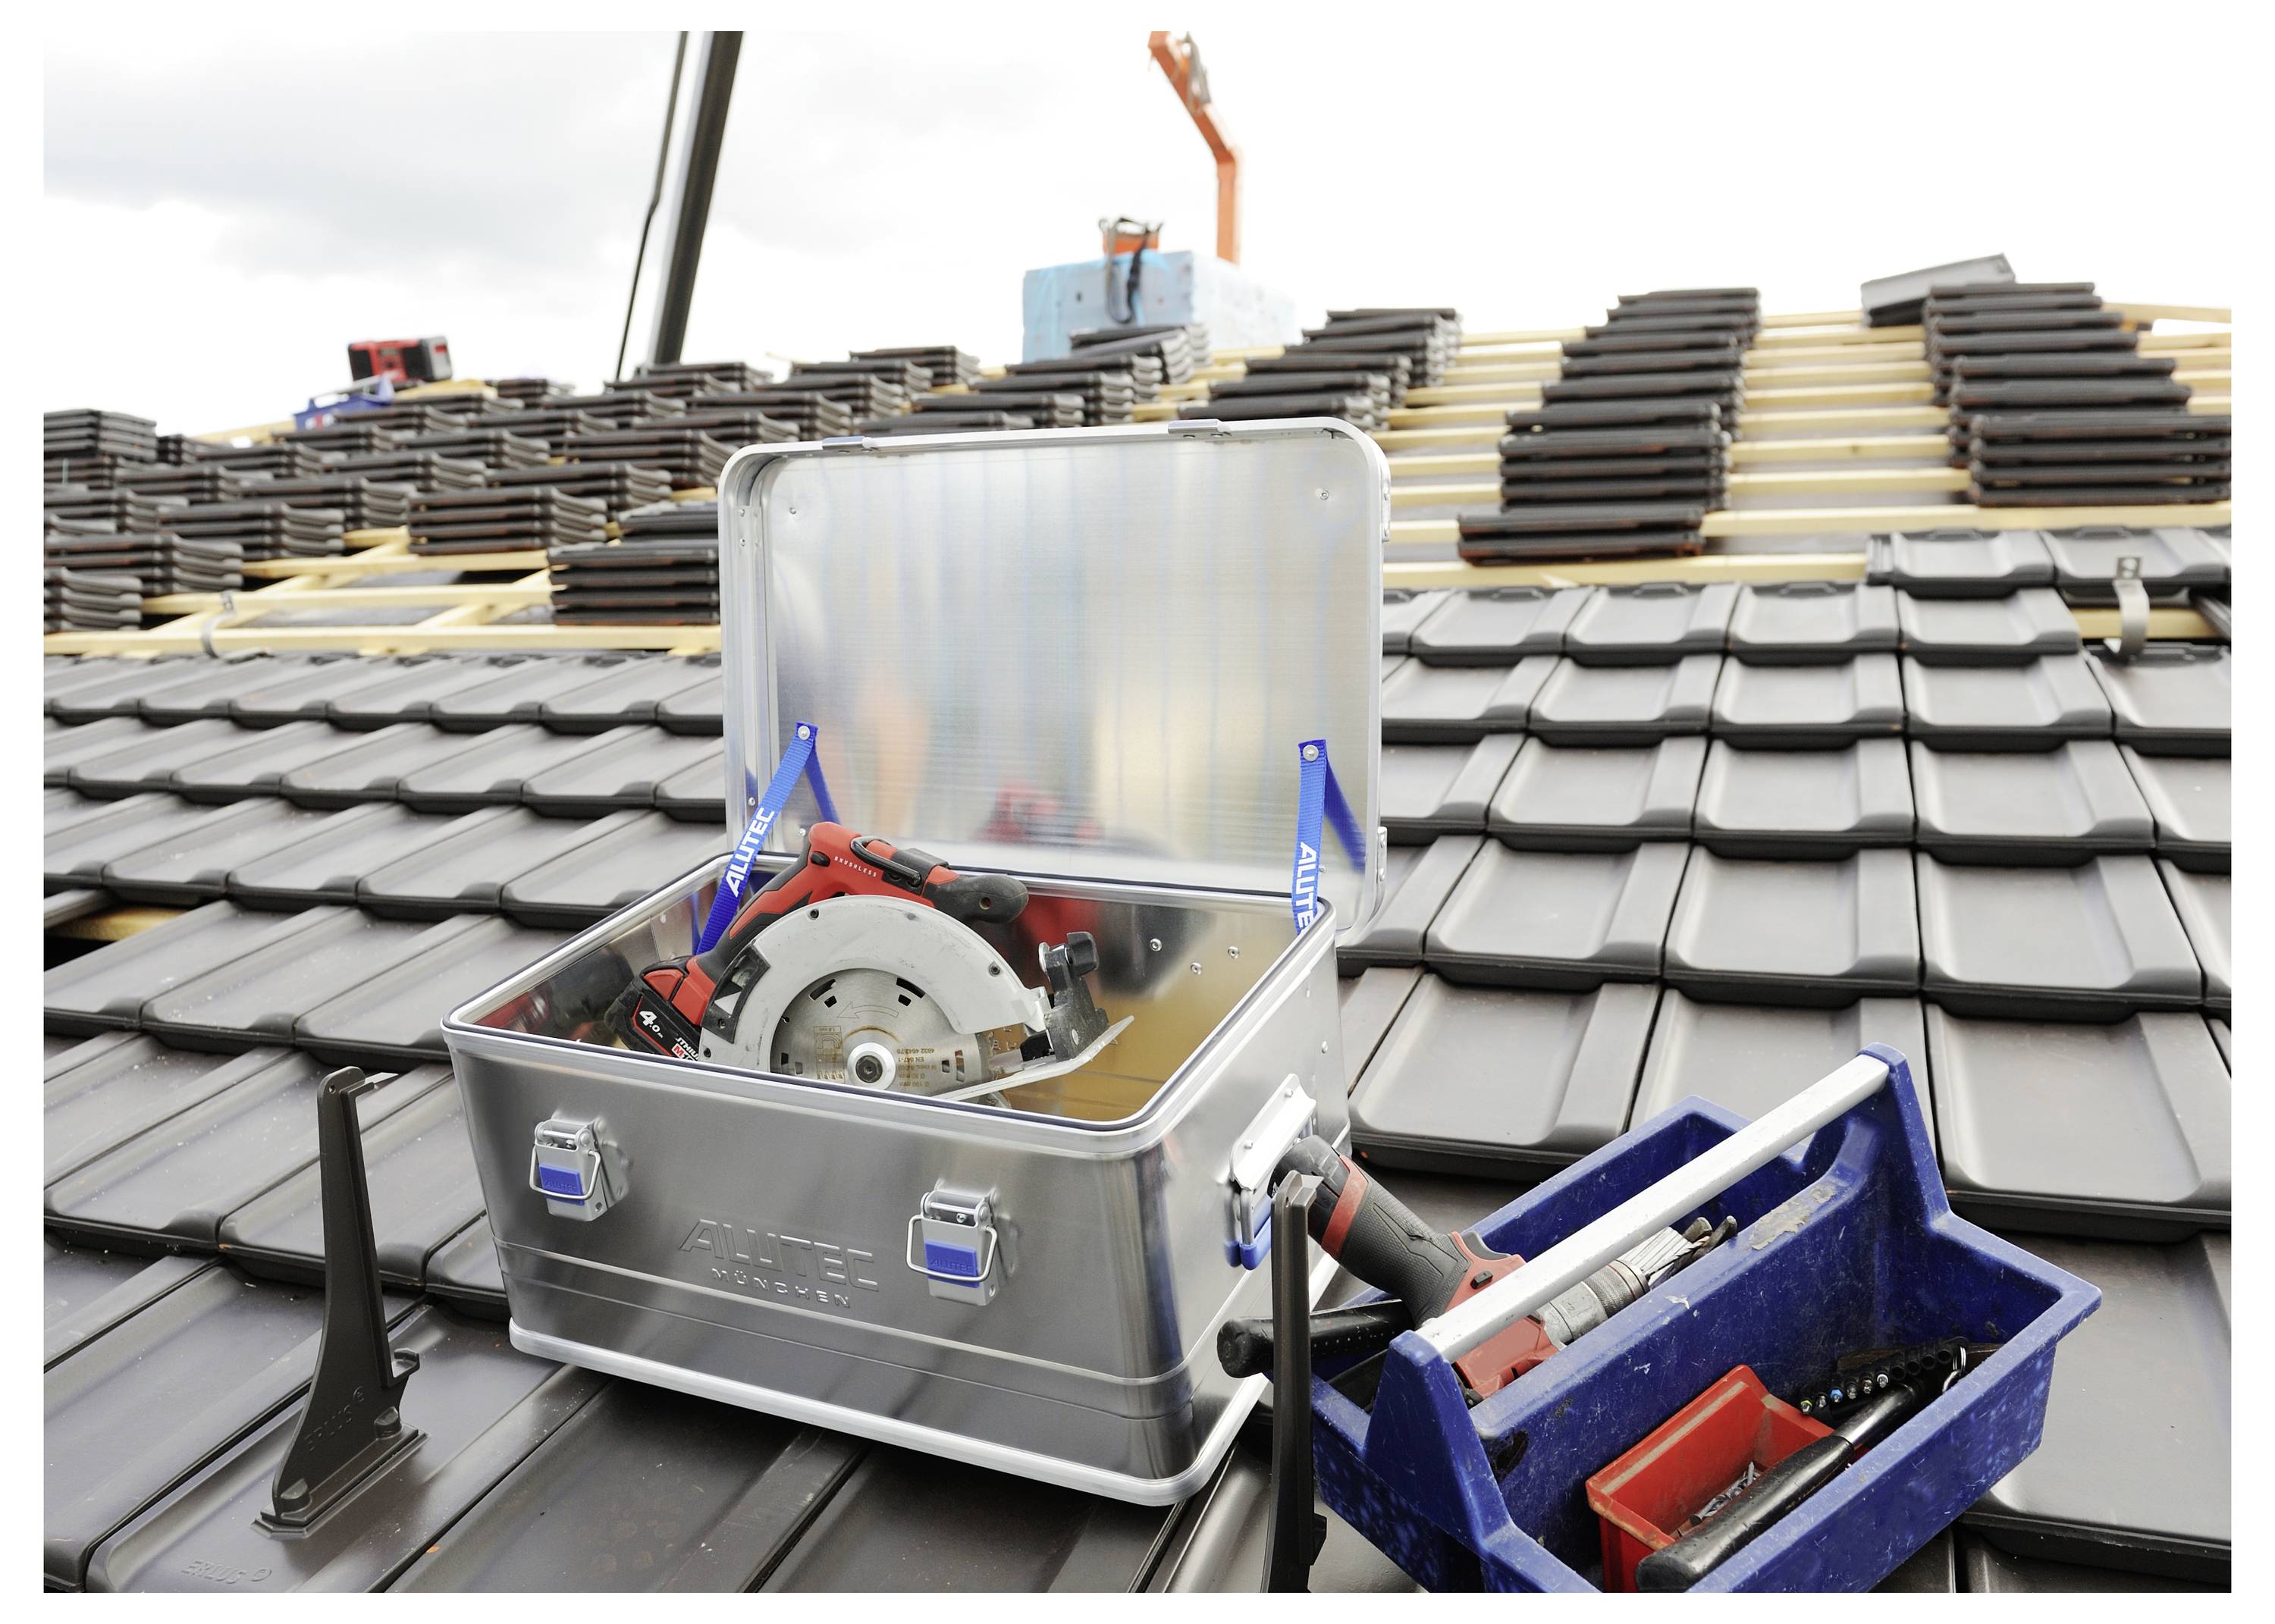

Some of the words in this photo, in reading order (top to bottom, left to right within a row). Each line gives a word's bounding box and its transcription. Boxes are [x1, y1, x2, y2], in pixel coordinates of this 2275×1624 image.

[726, 807, 774, 898] ALUTEC
[834, 856, 877, 877] BRUSHLESS
[1295, 842, 1316, 928] ALUTE
[679, 1218, 879, 1292] ALUTEC
[930, 1258, 974, 1274] ALUTEC
[711, 1268, 850, 1309] MÜNCHEN
